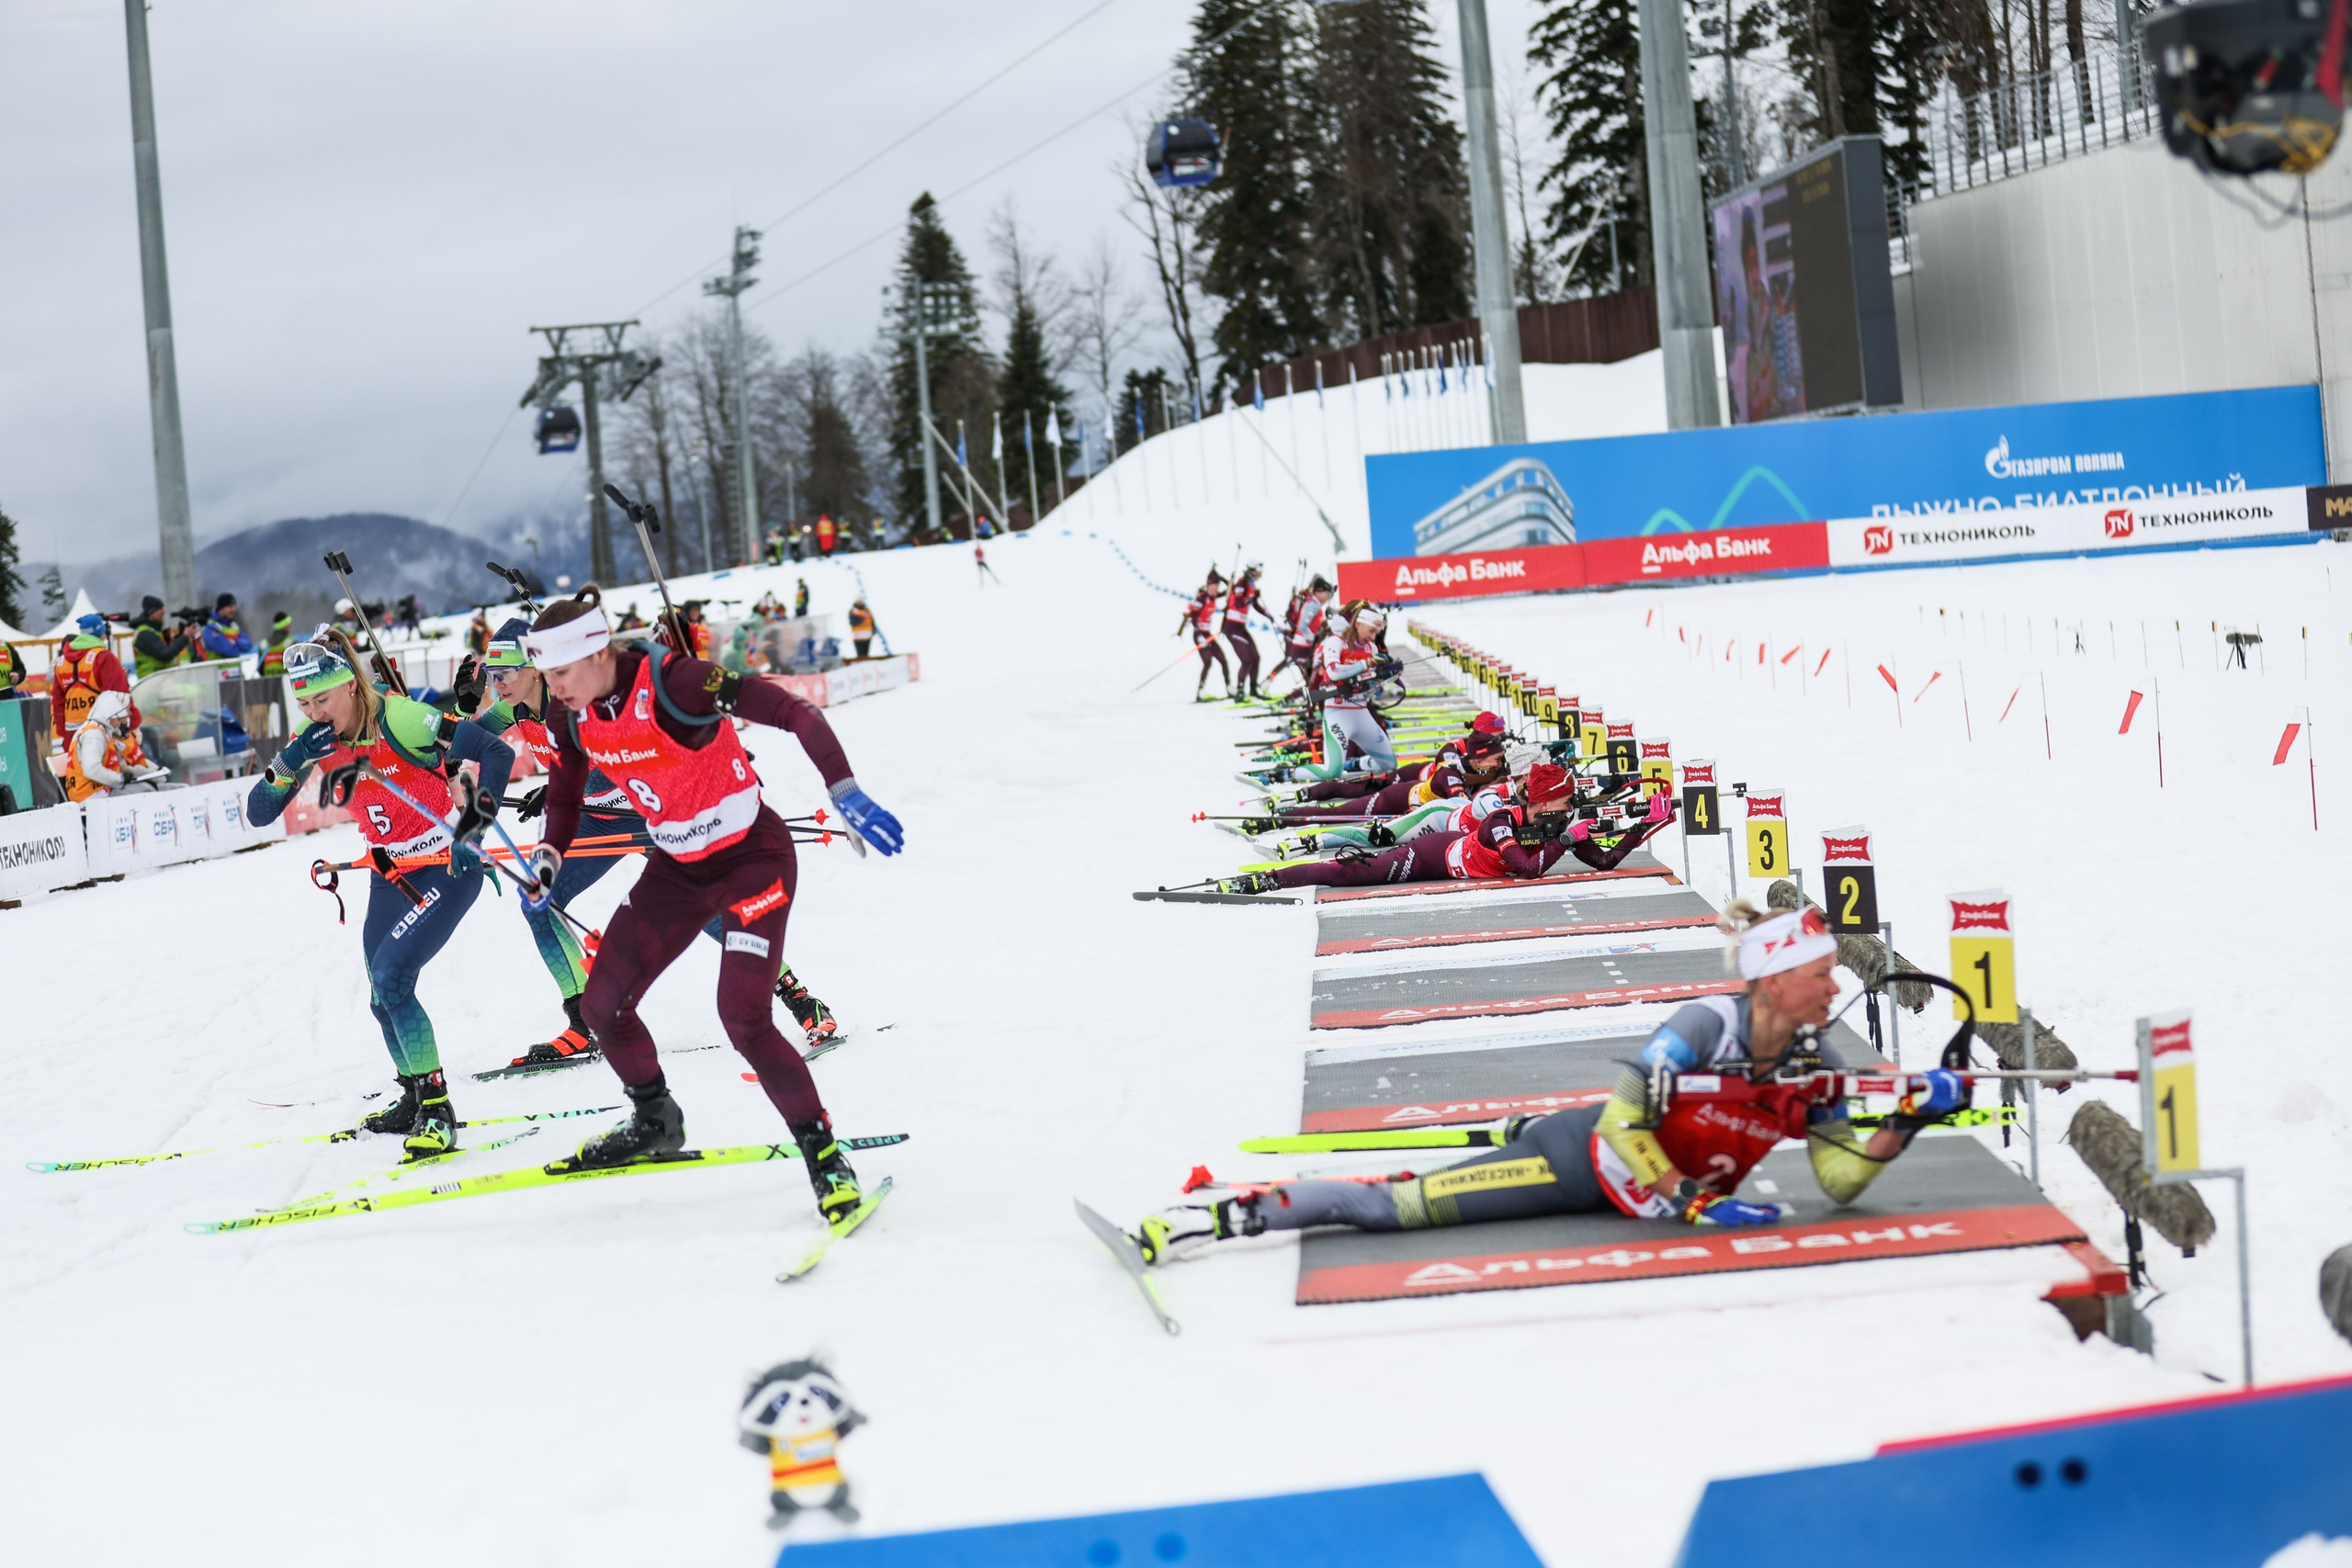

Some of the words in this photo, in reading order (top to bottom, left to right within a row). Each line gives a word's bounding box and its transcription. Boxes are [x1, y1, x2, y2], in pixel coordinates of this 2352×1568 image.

[2011, 456, 2072, 478] ГАЗПРОМ
[2075, 451, 2125, 473] ПОЛЯНА
[2139, 505, 2273, 528] ТЕХНОНИКОЛЬ
[1899, 525, 2035, 546] ТЕХНОНИКОЛЬ
[1642, 542, 1713, 570] Альфа
[1715, 537, 1771, 559] Банк
[1395, 564, 1468, 592] Альфа
[1470, 558, 1526, 581] Банк
[65, 696, 96, 710] УДЬЯ
[1524, 694, 1540, 715] 10
[1544, 703, 1553, 722] 9
[1565, 714, 1576, 739] 8
[621, 748, 660, 763] Банк
[1588, 731, 1599, 756] 7
[732, 758, 746, 781] 8
[1616, 745, 1629, 773] 6
[628, 778, 662, 813] 8
[1651, 767, 1664, 796] 5
[367, 805, 392, 836] 5
[1694, 794, 1709, 829] 4
[1752, 803, 1766, 811] Альфа
[654, 818, 722, 844] ХНОНИКОЛЬ
[1758, 829, 1774, 871] 3
[1831, 844, 1849, 854] Альфа
[1849, 844, 1863, 852] Банк
[741, 899, 768, 918] Альфа
[765, 889, 784, 905] Банк
[1839, 875, 1861, 925] 2
[1372, 929, 1534, 947] Альфа
[1544, 919, 1668, 933] Банк
[1973, 951, 1993, 1009] 1
[1379, 996, 1570, 1020] Альфа
[1584, 981, 1731, 1000] Банк
[1383, 1091, 1613, 1123] Альфа
[1692, 1102, 1746, 1134] Альфа
[2160, 1085, 2177, 1159] 1
[857, 1134, 901, 1146] SPEED
[415, 1156, 441, 1168] FISCHER
[565, 1168, 628, 1181] FISCHER
[1696, 1153, 1738, 1190] 2
[219, 1204, 337, 1232] FISCHER
[1404, 1243, 1712, 1285] Альфа
[1731, 1221, 1966, 1256] Банк
